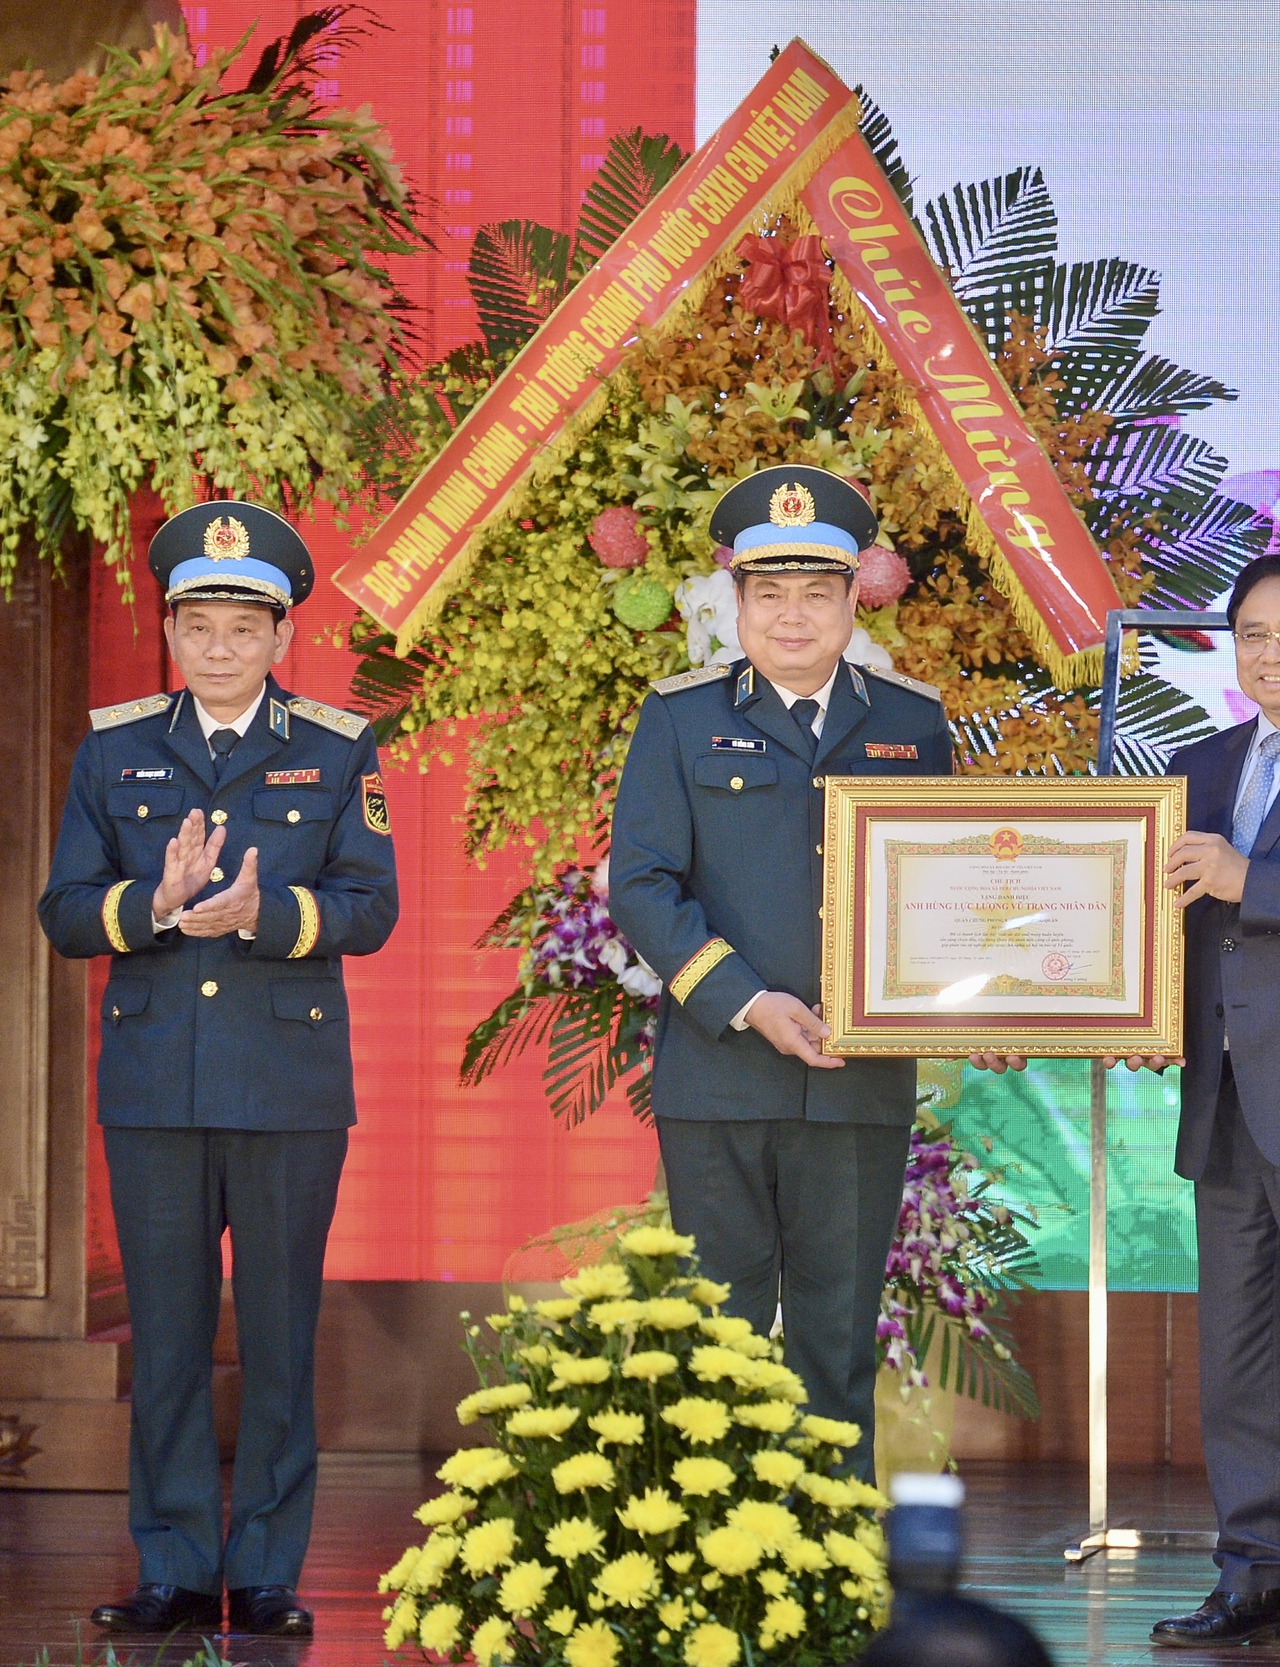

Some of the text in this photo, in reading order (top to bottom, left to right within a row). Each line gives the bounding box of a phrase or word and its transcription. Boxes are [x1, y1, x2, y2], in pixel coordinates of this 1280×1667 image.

[772, 68, 829, 125] NAM
[725, 140, 768, 183] CN
[744, 106, 796, 158] VIỆT
[688, 165, 748, 225] CHXH
[649, 208, 710, 269] NƯỚC
[620, 241, 672, 301] PHỦ
[581, 281, 645, 348] CHÍNH
[536, 330, 605, 400] TƯỚNG
[828, 176, 1056, 559] Chúc Mừng
[510, 373, 560, 431] THỦ
[463, 421, 528, 489] CHÍNH
[426, 470, 487, 533] MINH
[387, 512, 452, 580] PHẠM
[363, 560, 413, 608] Đ/C
[903, 900, 1108, 913] ANH HÙNG LỰC LƯỢNG VŨ TRANG NHÂN DÂN
